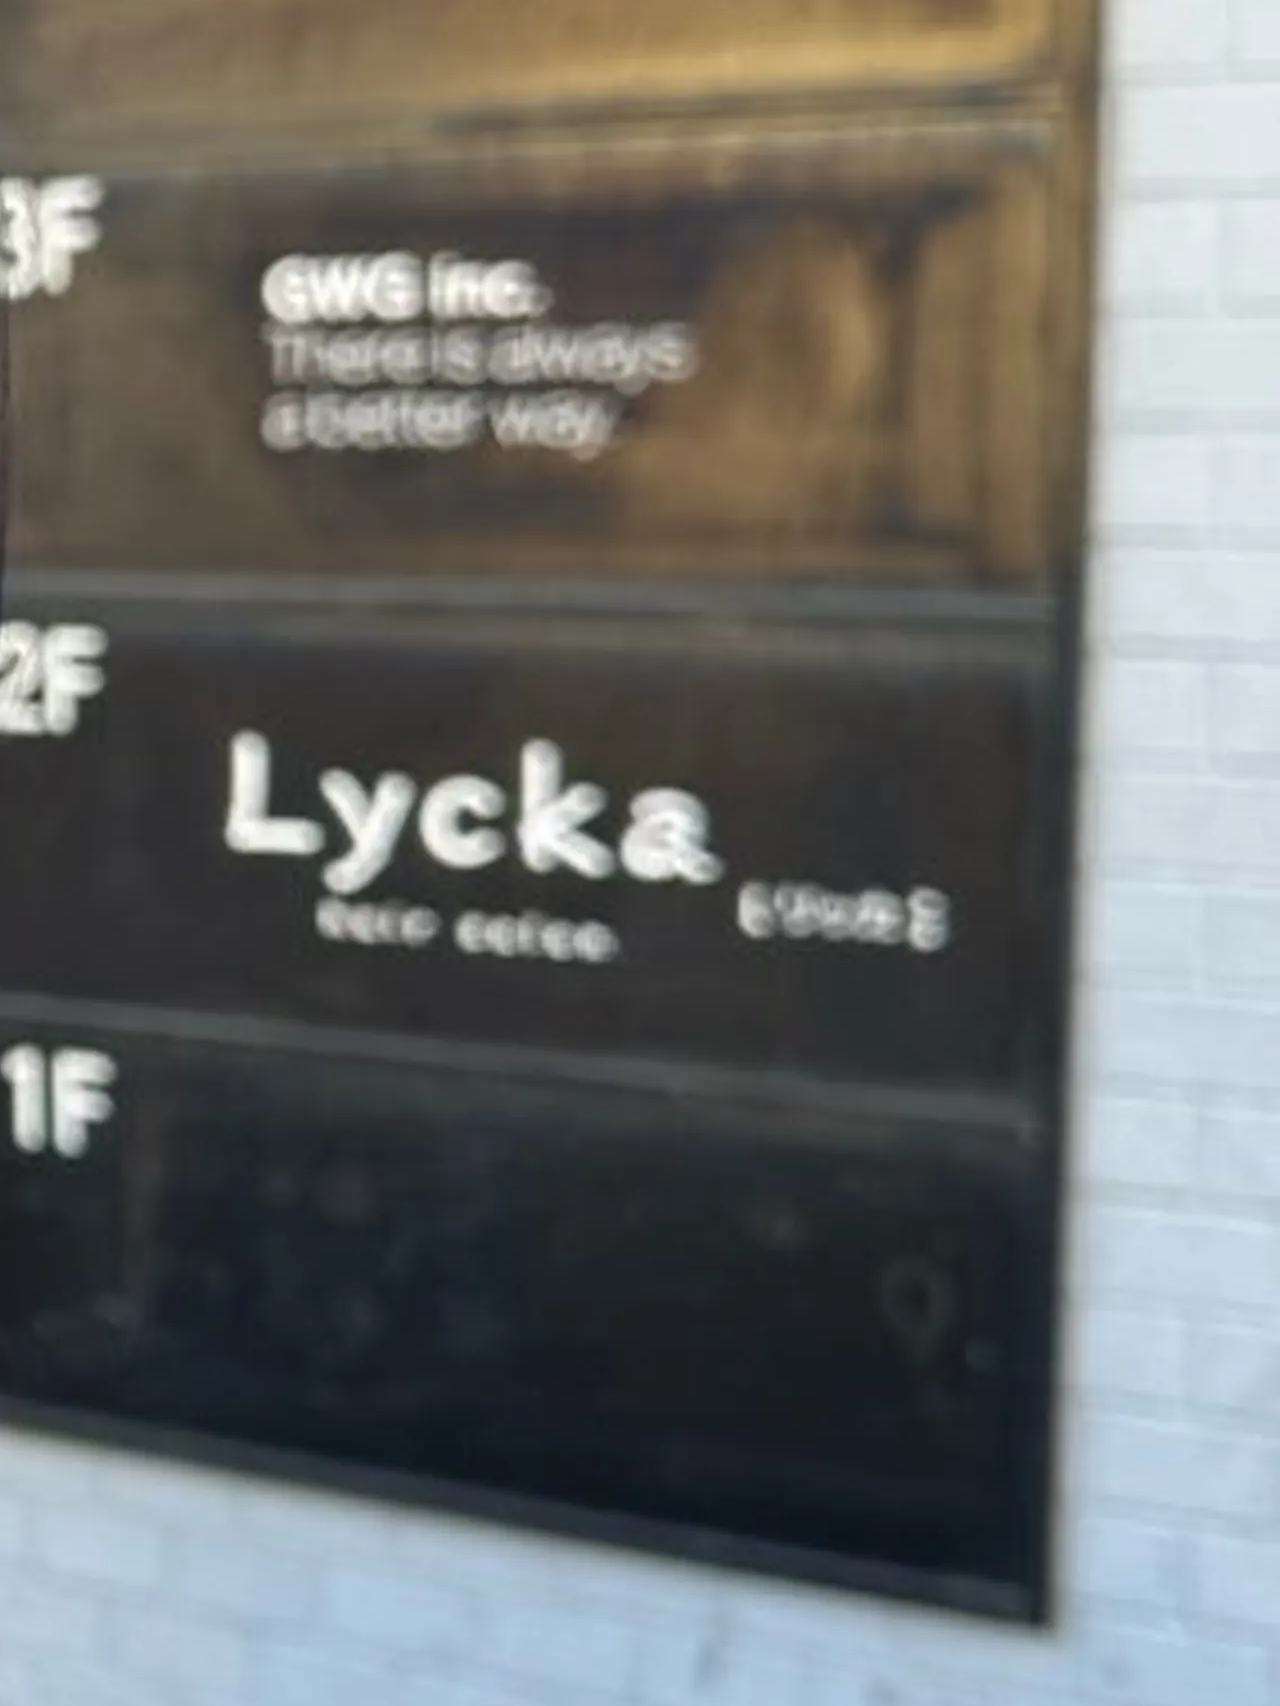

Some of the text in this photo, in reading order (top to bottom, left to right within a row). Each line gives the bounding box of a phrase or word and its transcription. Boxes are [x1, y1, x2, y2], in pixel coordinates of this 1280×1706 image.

[488, 323, 698, 393] always
[224, 730, 725, 894] Lycka
[0, 1043, 118, 1158] 1F
